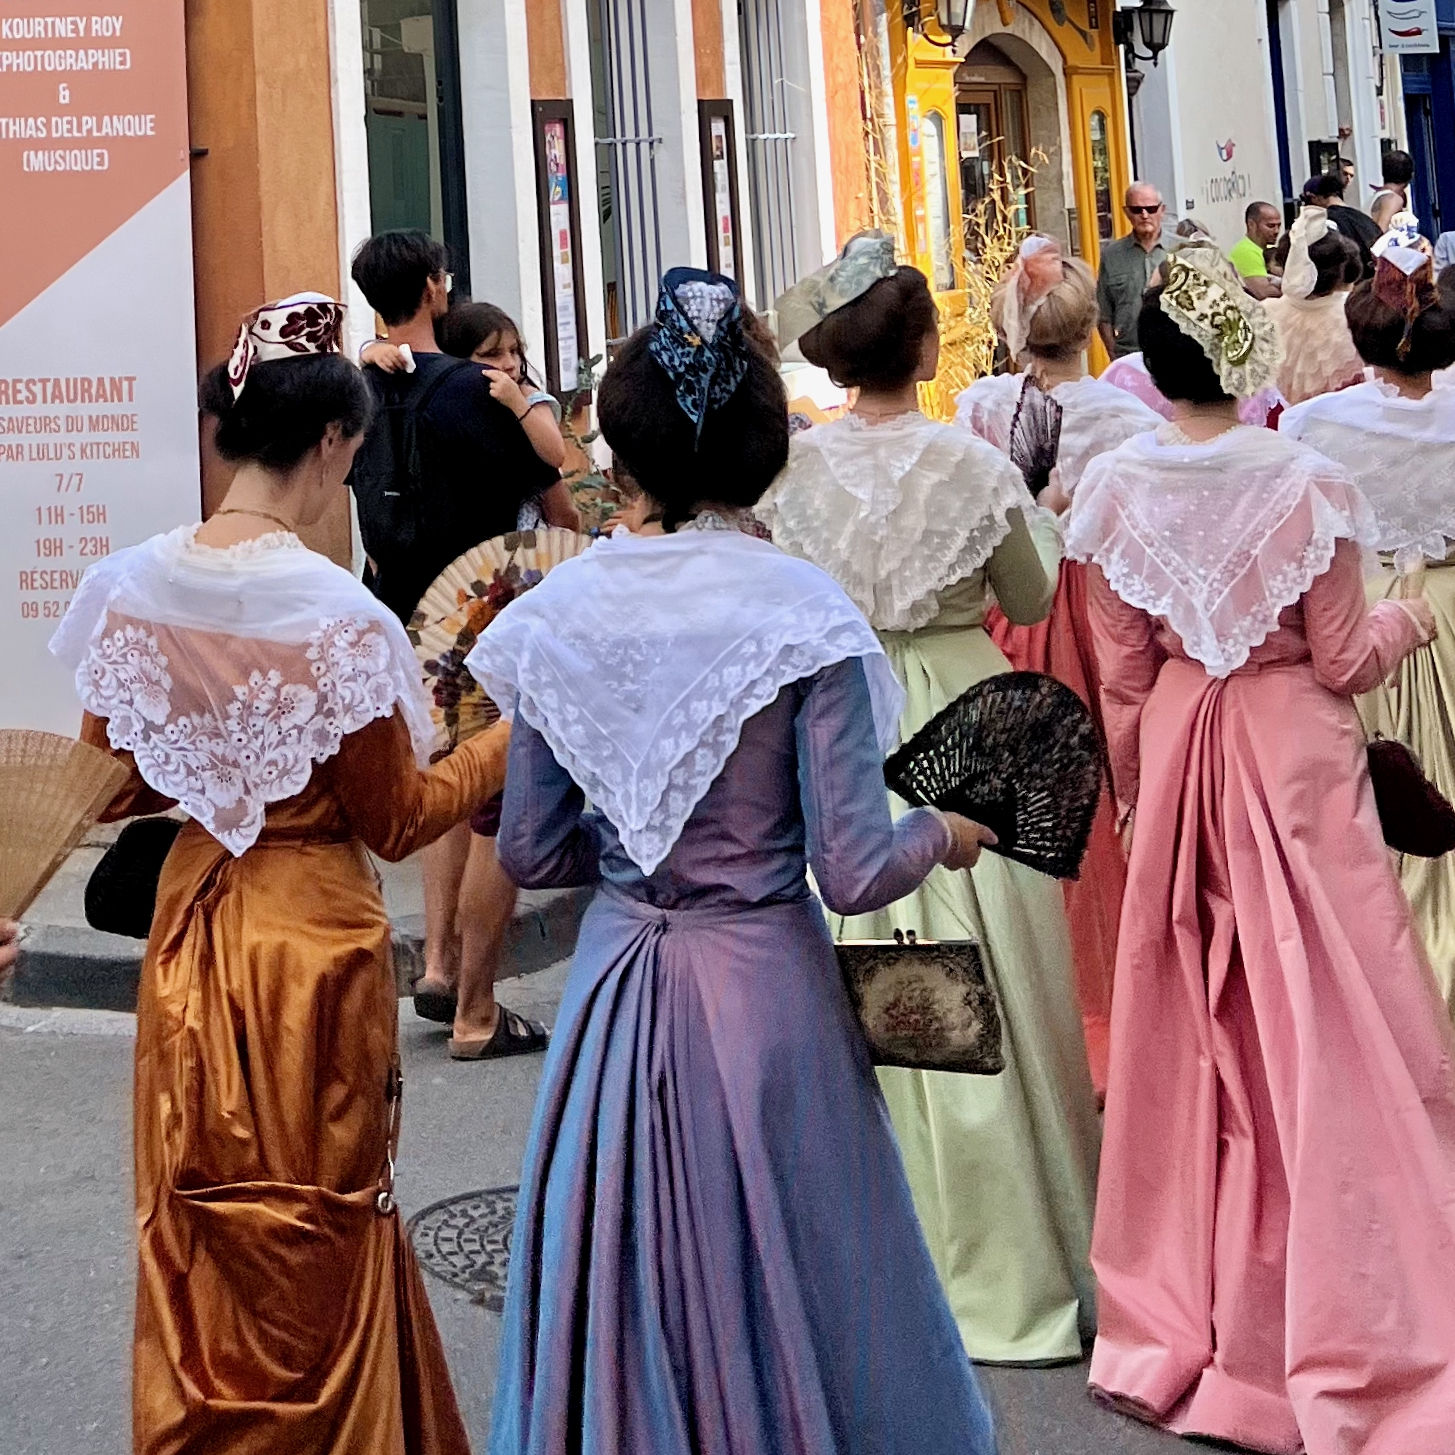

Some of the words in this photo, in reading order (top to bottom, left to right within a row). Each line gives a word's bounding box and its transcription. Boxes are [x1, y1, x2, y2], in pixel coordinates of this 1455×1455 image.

[1, 16, 87, 39] KOURTNEY
[90, 15, 123, 37] ROY
[58, 83, 70, 105] &
[51, 114, 155, 138] DELPLANQUE
[65, 415, 86, 434] DU
[89, 413, 139, 433] MONDE
[28, 442, 76, 462] LULU'S
[80, 440, 140, 460] KITCHEN
[55, 473, 85, 493] 7/7
[35, 505, 65, 526] 11H
[78, 504, 107, 525] 15H
[33, 537, 64, 558] 19H
[78, 536, 110, 556] 23H
[21, 601, 39, 618] 09
[43, 601, 60, 618] 52
